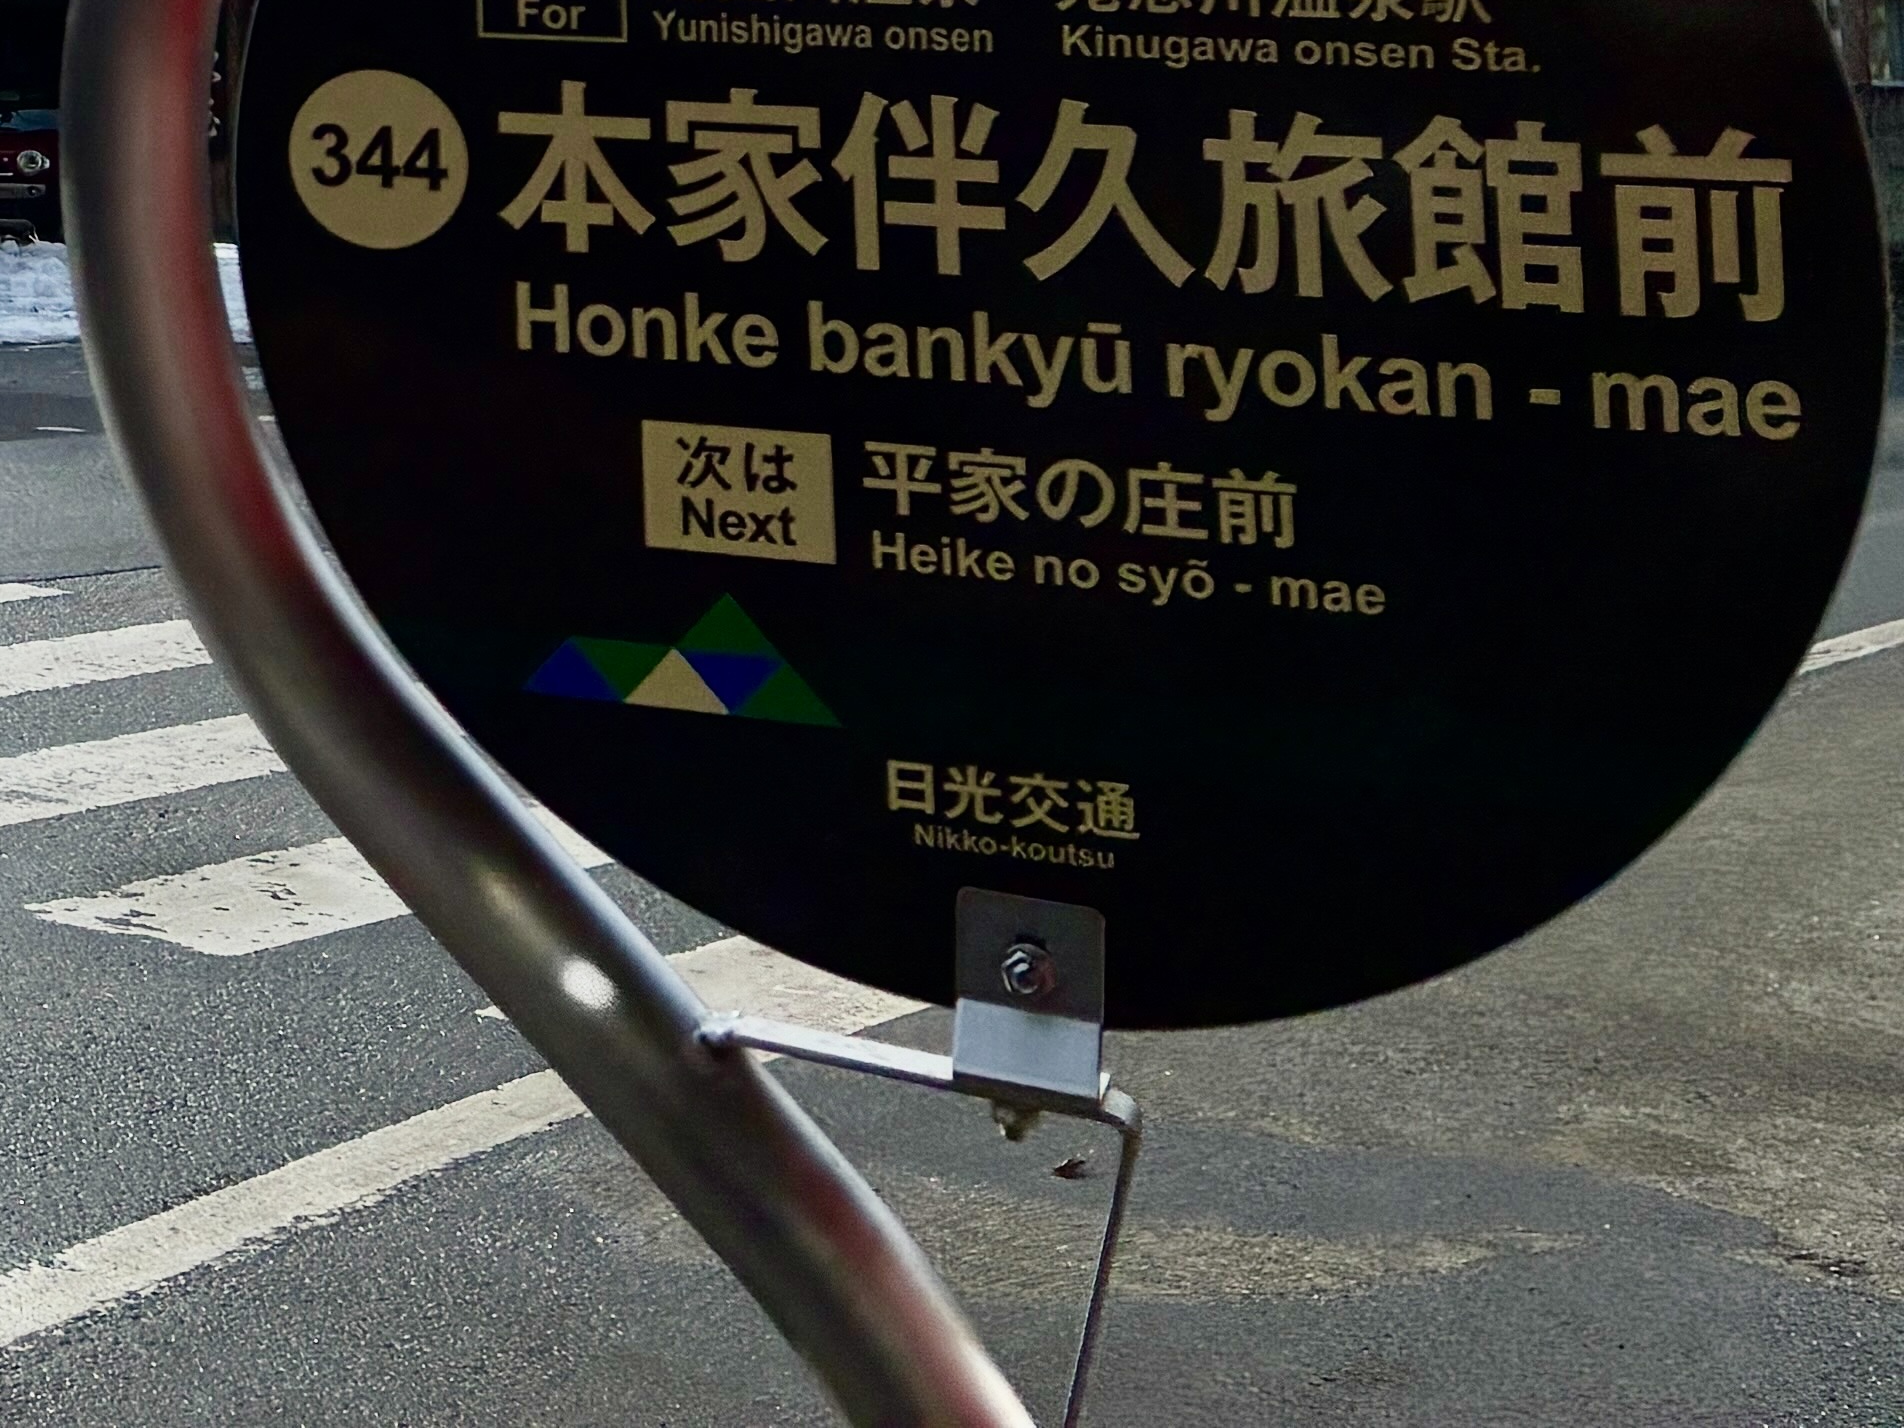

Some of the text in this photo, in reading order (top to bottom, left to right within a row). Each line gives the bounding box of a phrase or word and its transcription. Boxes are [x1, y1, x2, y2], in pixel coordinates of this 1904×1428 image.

[653, 11, 994, 54] Yunishigawa onsen
[1062, 24, 1541, 73] Kinugawa onsen Sta.
[311, 122, 450, 192] 344
[498, 79, 1793, 322] 本家伴久旅館前
[516, 281, 780, 369] Honke
[808, 300, 1133, 408] bankyū
[1166, 333, 1494, 423] ryokan
[1592, 371, 1802, 441] mae
[675, 435, 798, 495] 次は
[862, 440, 1298, 550] 平家の庄前
[680, 495, 799, 548] Next
[872, 529, 1016, 582] Heike
[1034, 555, 1101, 590] no
[1271, 576, 1386, 616] mae
[886, 759, 1142, 840] 日光交通
[913, 822, 1116, 870] Nikko-koutsu
